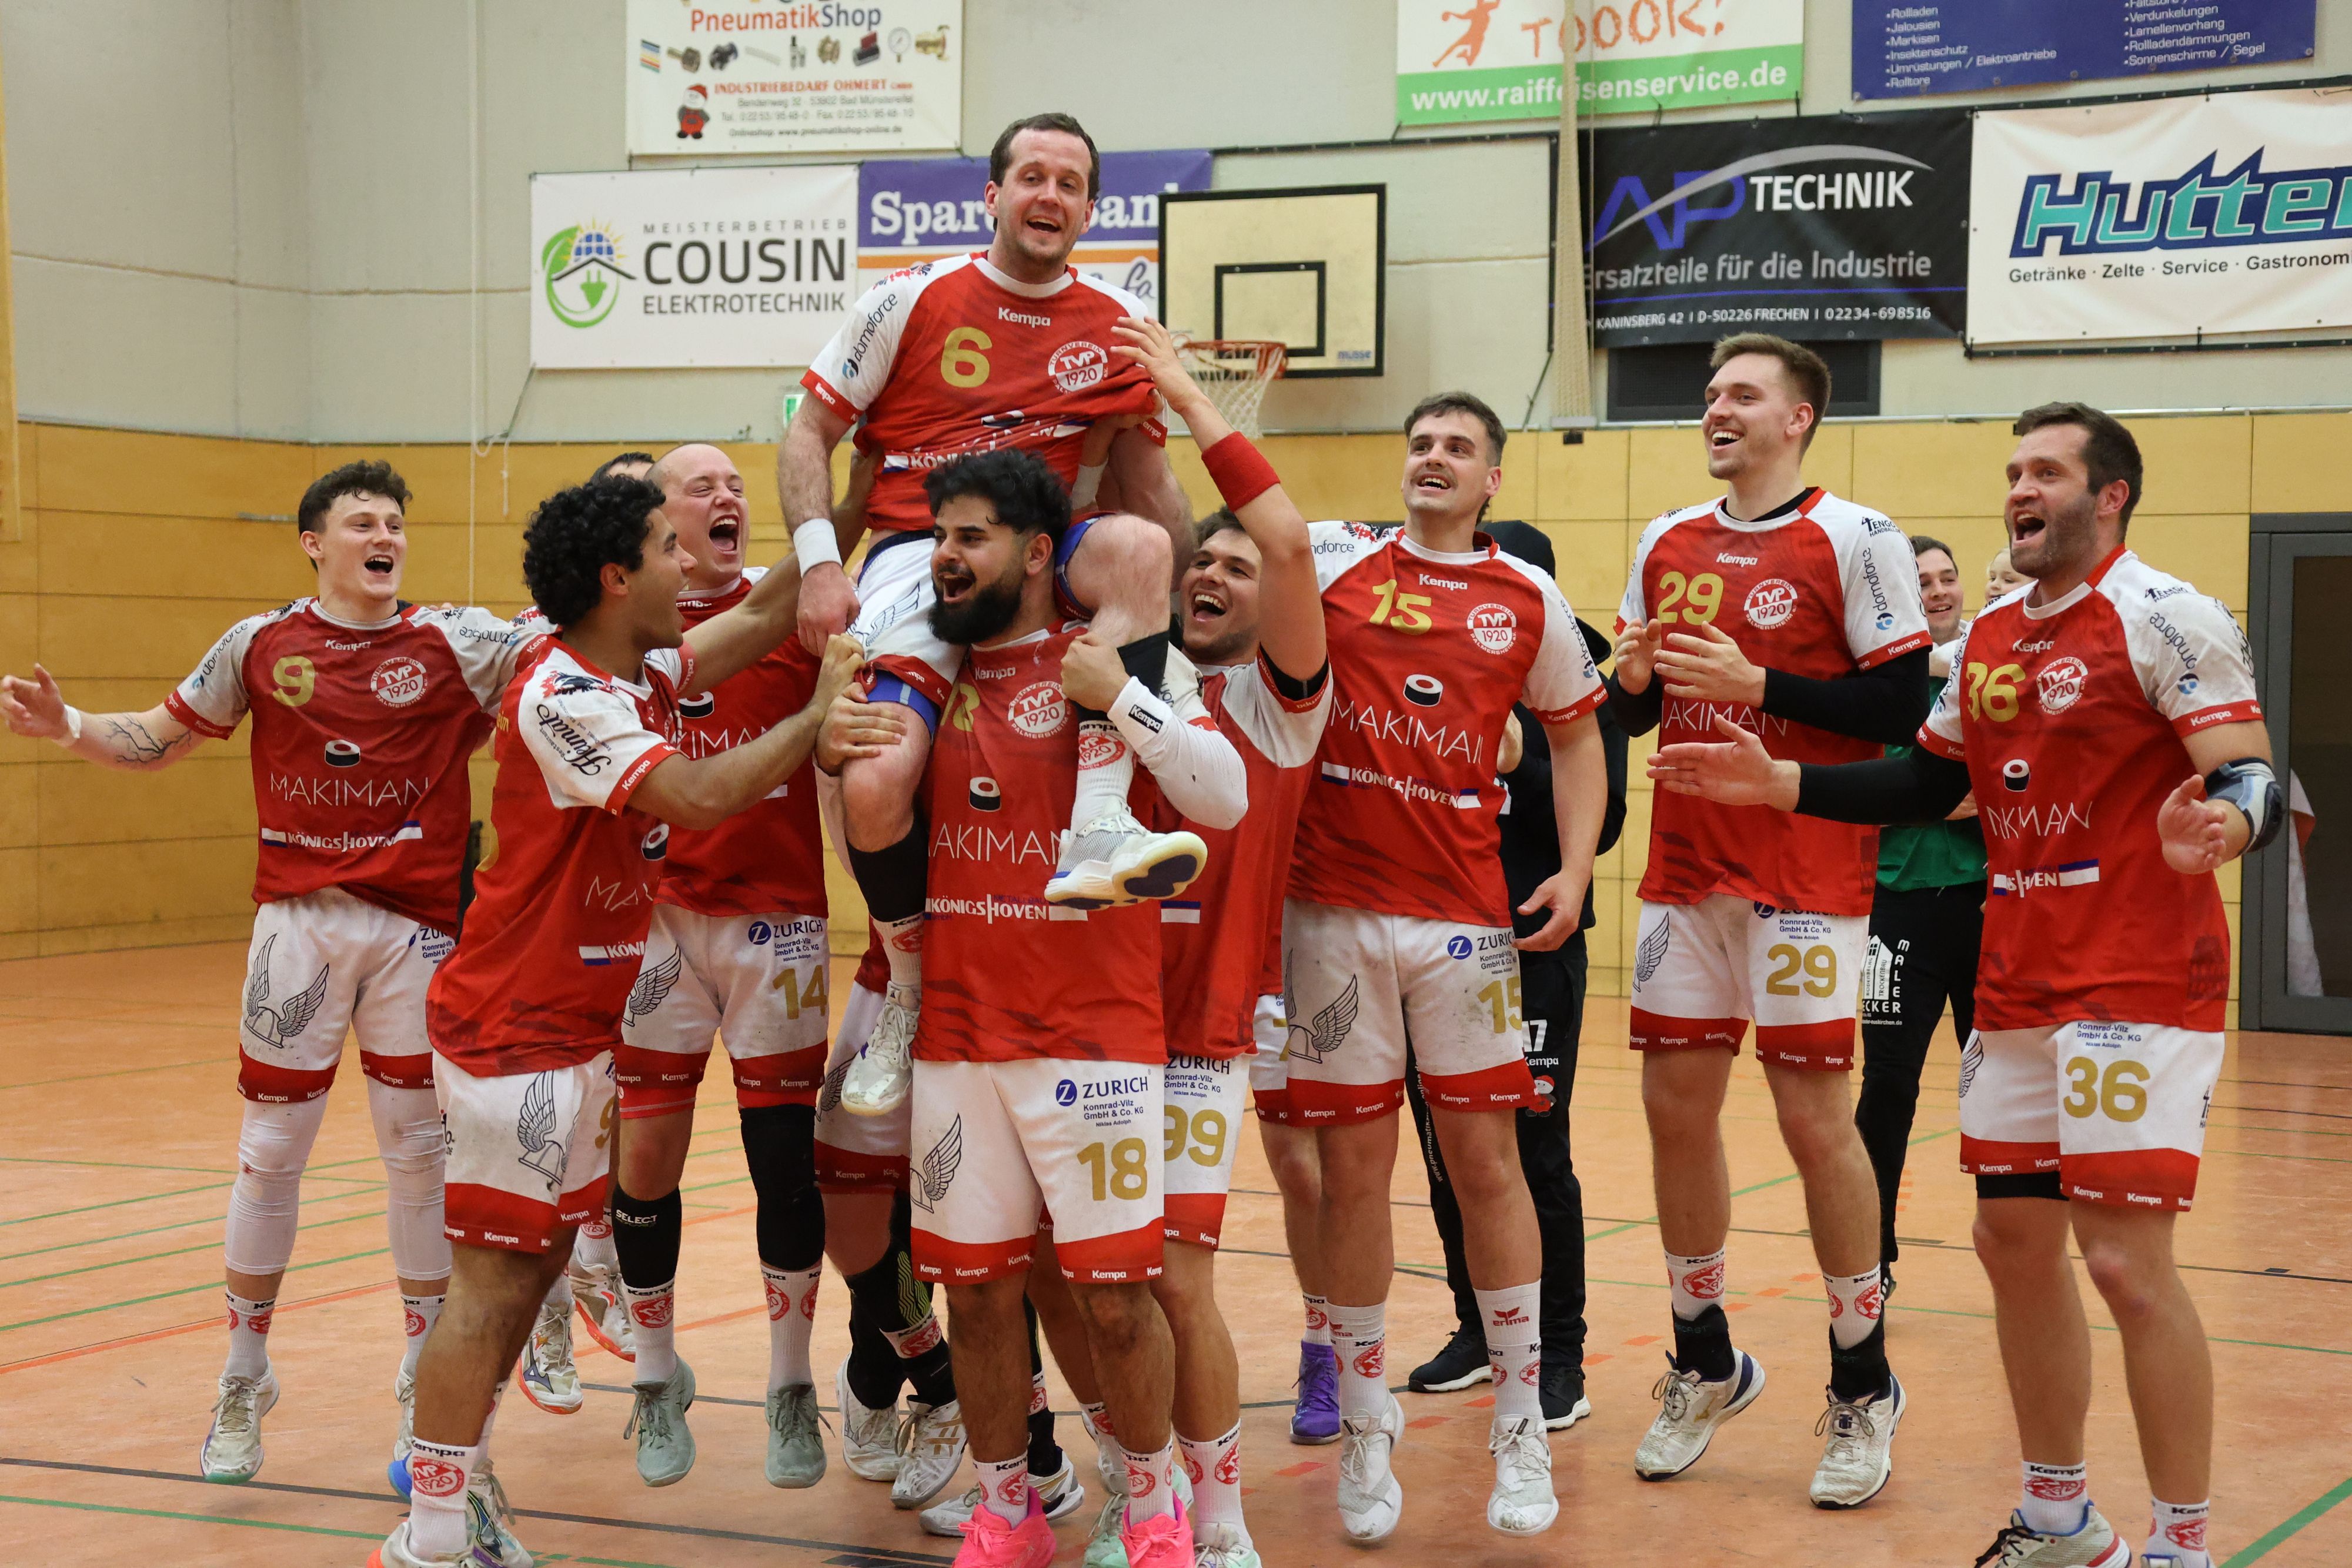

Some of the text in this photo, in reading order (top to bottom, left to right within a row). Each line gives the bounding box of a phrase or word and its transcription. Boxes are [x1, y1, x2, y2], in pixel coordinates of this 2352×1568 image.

[691, 5, 881, 32] PneumatikShop
[2129, 5, 2218, 22] Verdunkelungen
[2130, 19, 2225, 37] Lamellenvorhang
[1890, 34, 1940, 46] Markisen
[1890, 45, 1969, 60] Insektenschutz
[2129, 49, 2216, 66] Sonnenschirme
[2233, 42, 2265, 56] Segel
[1749, 170, 1915, 212] TECHNIK
[643, 218, 847, 233] MEISTERBETRIEB
[643, 237, 846, 285] COUSIN
[1717, 254, 1754, 281] für
[1761, 252, 1802, 279] die
[1812, 249, 1931, 279] Industrie
[2009, 266, 2086, 283] Getränke
[2103, 263, 2144, 278] Zelte
[2162, 259, 2229, 275] Service
[643, 293, 846, 314] ELEKTROTECHNIK
[998, 307, 1051, 328] Kempa
[1596, 306, 1931, 329] KANINSBERG 42 D-50226 FRECHEN 02234-698516
[854, 293, 898, 362] domoforce
[941, 326, 993, 388] 6
[1060, 350, 1095, 370] TVP
[1065, 367, 1097, 386] 1920
[1716, 552, 1758, 567] Kempa
[1419, 573, 1468, 591] Kempa
[1863, 547, 1888, 611] domoforce
[1657, 571, 1724, 626] 29
[1756, 588, 1785, 606] TVP
[1369, 579, 1432, 636] 15
[1756, 603, 1786, 619] 1920
[1477, 613, 1507, 627] TVP
[1482, 630, 1508, 642] 1920
[2150, 612, 2198, 670] omoforce
[1887, 637, 1920, 656] Kempa
[272, 656, 315, 707] 9
[380, 665, 413, 685] TVP
[975, 667, 1016, 680] Kempa
[2043, 666, 2075, 687] TVP
[387, 680, 418, 698] 1920
[1966, 661, 2026, 723] 36
[2047, 682, 2075, 704] 1920
[1020, 688, 1054, 712] TVP
[1024, 706, 1059, 727] 1920
[1130, 706, 1162, 733] Kempa
[1548, 709, 1578, 722] Kempa
[2190, 710, 2232, 727] Kempa
[537, 704, 612, 776] Heimat
[622, 759, 651, 791] Kempa
[931, 894, 1047, 924] KÖNIGSHOVEN
[773, 920, 823, 938] ZURICH
[1477, 931, 1515, 951] ZURIC
[1481, 960, 1500, 969] GmbH
[1766, 944, 1837, 998] 29
[1879, 959, 1887, 997] TROCKENBAU
[773, 965, 828, 1020] 14
[1476, 975, 1522, 1034] 15
[2077, 1022, 2129, 1033] Konnrad-Vilz
[2077, 1031, 2100, 1039] GmbH
[2111, 1033, 2125, 1041] Co.
[1660, 1037, 1688, 1046] Kempa
[1780, 1051, 1807, 1063] Kempa
[380, 1071, 403, 1085] Kempa
[662, 1073, 690, 1082] Kempa
[780, 1079, 810, 1088] Kempa
[1164, 1074, 1213, 1084] Konnrad-Vilz
[1198, 1083, 1210, 1091] Co.
[258, 1086, 326, 1103] Kempa Kempa
[1082, 1076, 1149, 1099] ZURICH
[2063, 1057, 2151, 1122] 36
[1083, 1100, 1134, 1112] Konnrad-Vilz
[1441, 1092, 1521, 1104] Kempa Kempa
[1084, 1106, 1144, 1121] GmbH & Co. KG
[1304, 1102, 1384, 1118] Kempa Kempa
[1077, 1138, 1147, 1201] 18
[1979, 1164, 2012, 1174] Kempa
[2073, 1186, 2161, 1205] Kempa Kempa
[616, 1209, 658, 1224] SELECT
[485, 1210, 590, 1245] Kempa Kempa
[955, 1265, 988, 1278] Kempa
[1092, 1269, 1127, 1281] Kempa
